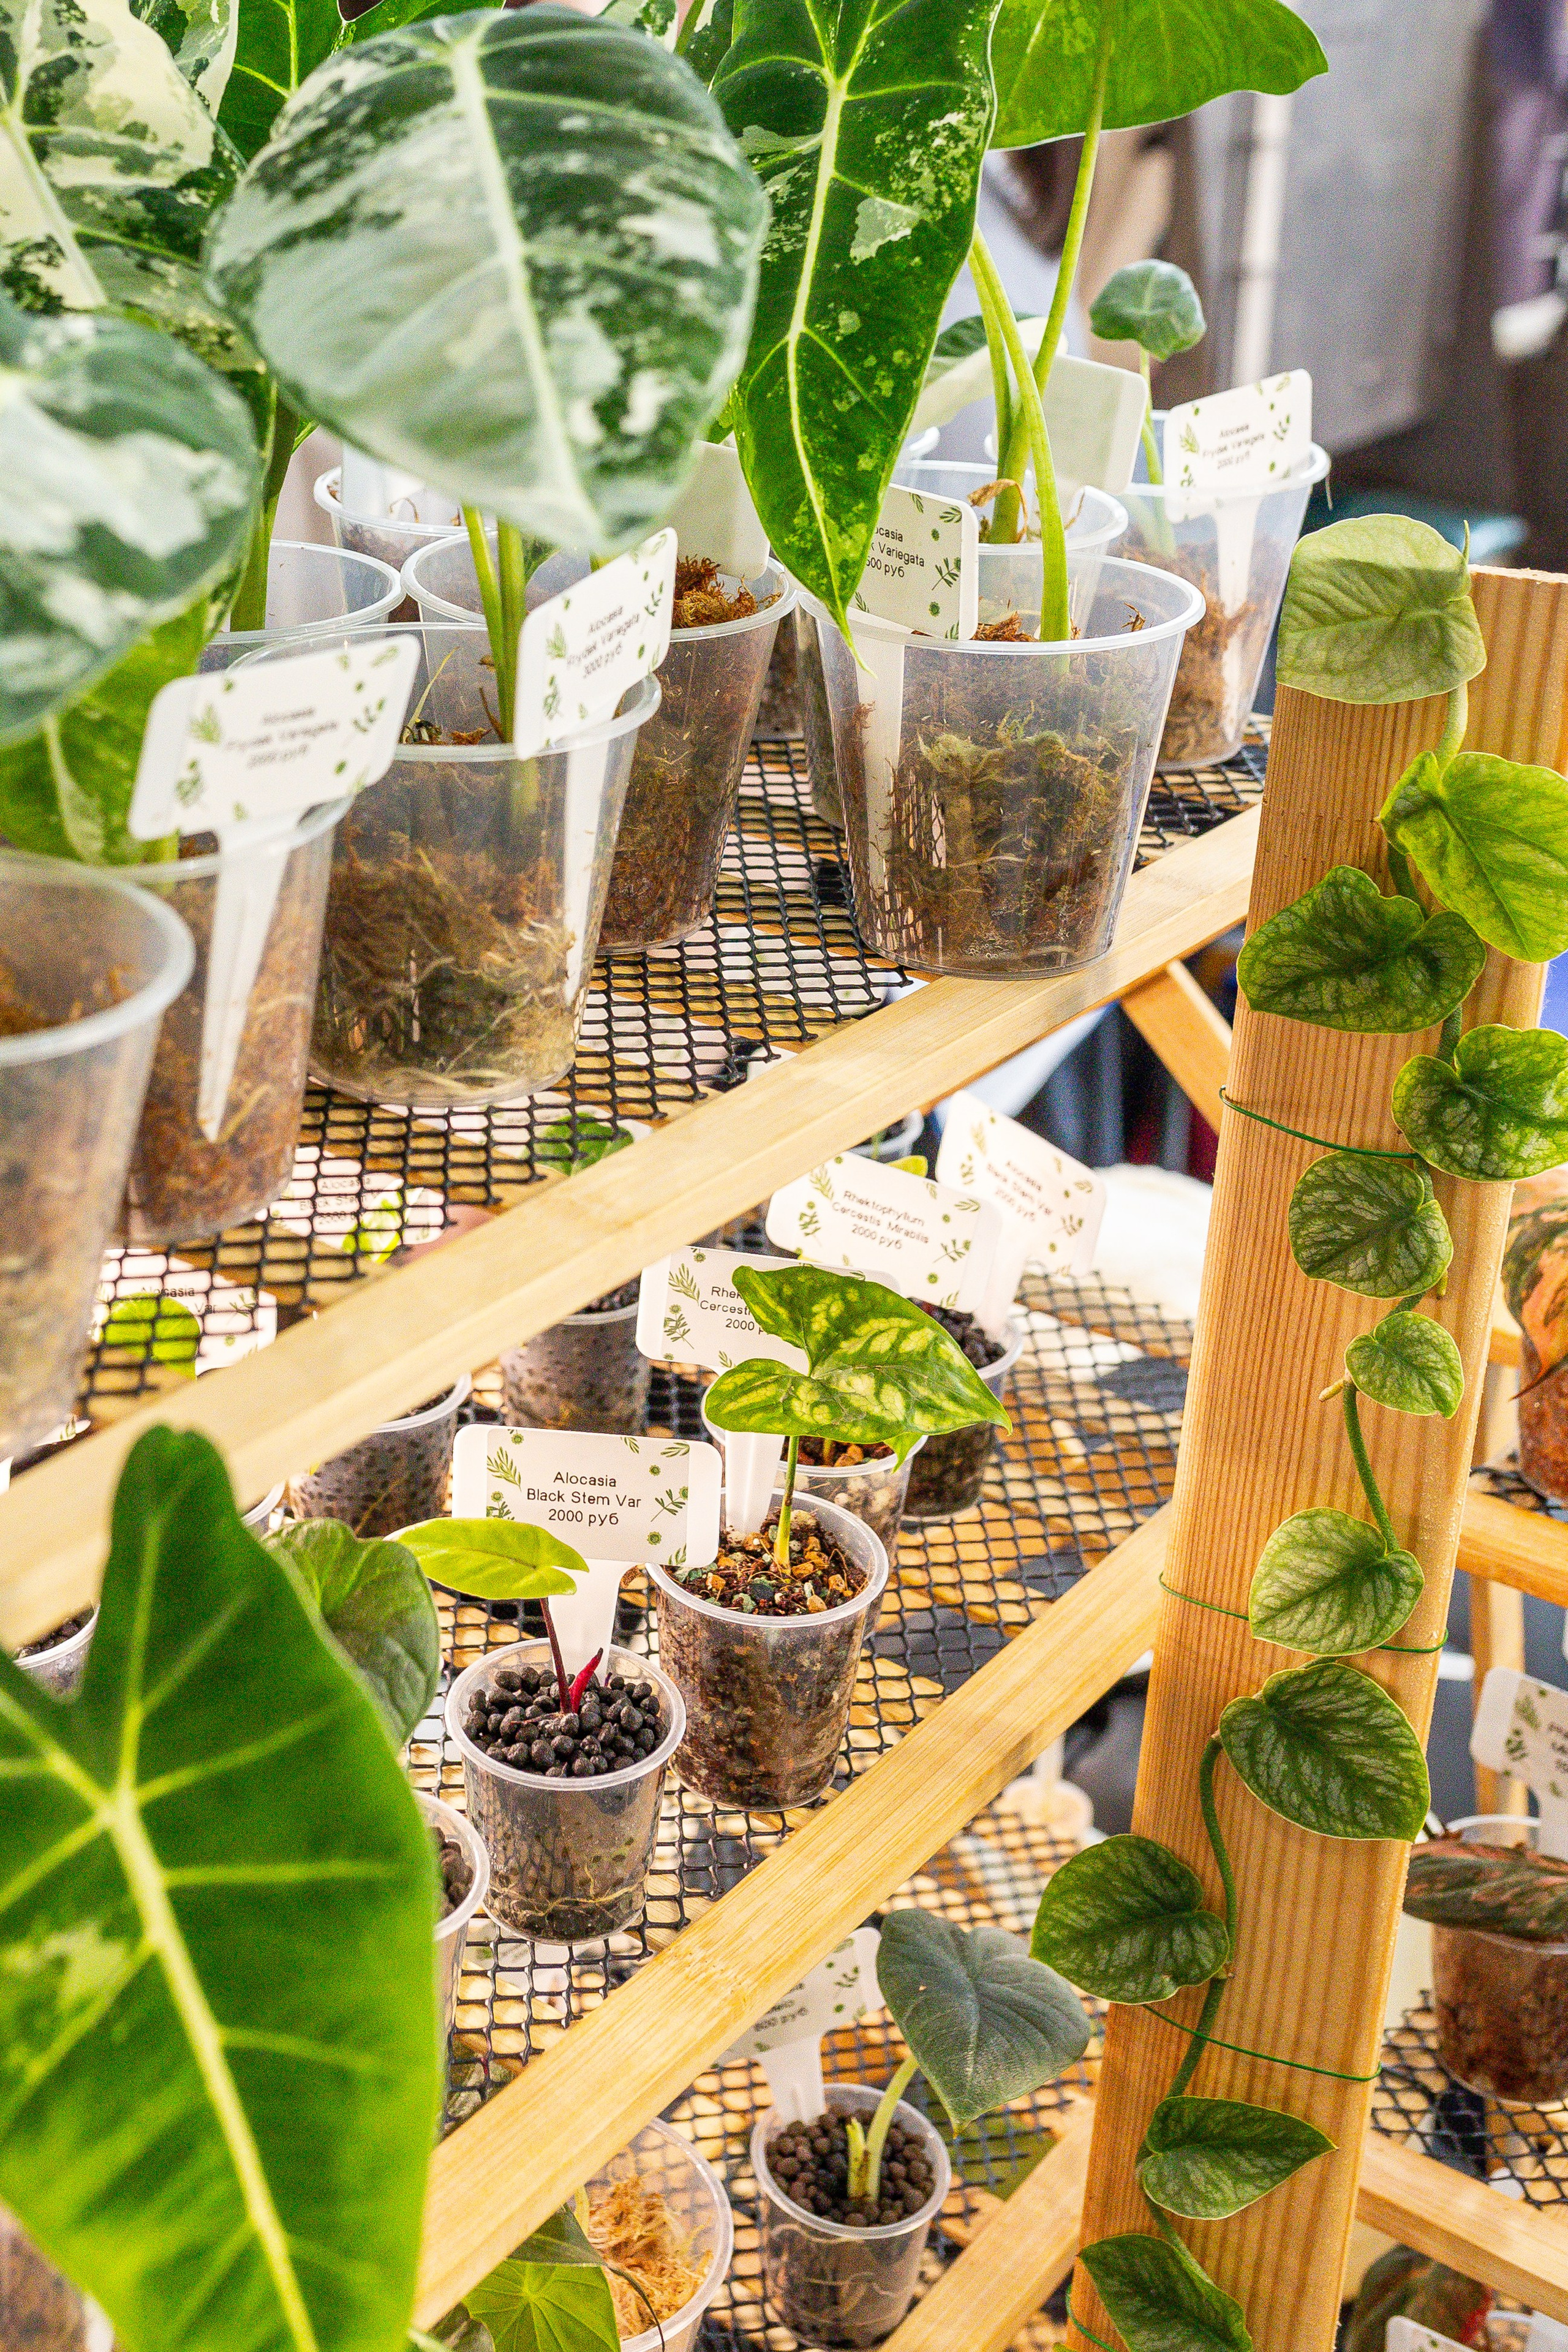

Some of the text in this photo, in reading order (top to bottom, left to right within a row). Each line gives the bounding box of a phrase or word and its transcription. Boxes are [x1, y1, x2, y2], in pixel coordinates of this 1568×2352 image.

[878, 541, 924, 567] Variegata
[884, 564, 904, 578] руб
[851, 1223, 877, 1241] 2000
[725, 1318, 755, 1331] 2000
[553, 1471, 617, 1487] Alocasia
[527, 1488, 642, 1508] Black Stem Var
[548, 1509, 619, 1527] 2000 руб
